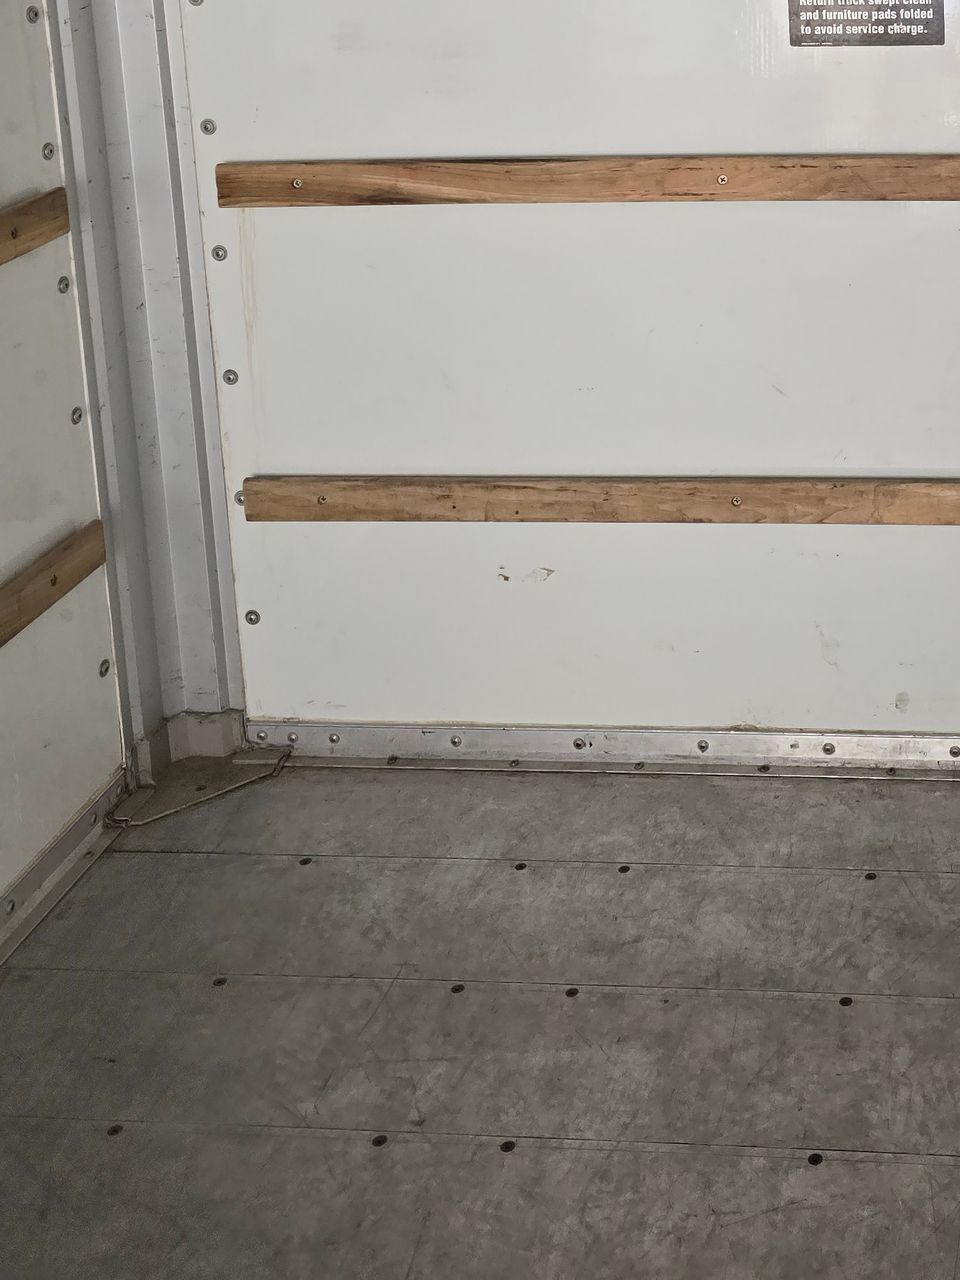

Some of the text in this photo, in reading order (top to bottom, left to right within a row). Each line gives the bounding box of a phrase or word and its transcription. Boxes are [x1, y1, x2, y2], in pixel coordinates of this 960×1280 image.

[800, 8, 933, 21] and furniture pads folded
[800, 23, 928, 36] to avoid service charge.
